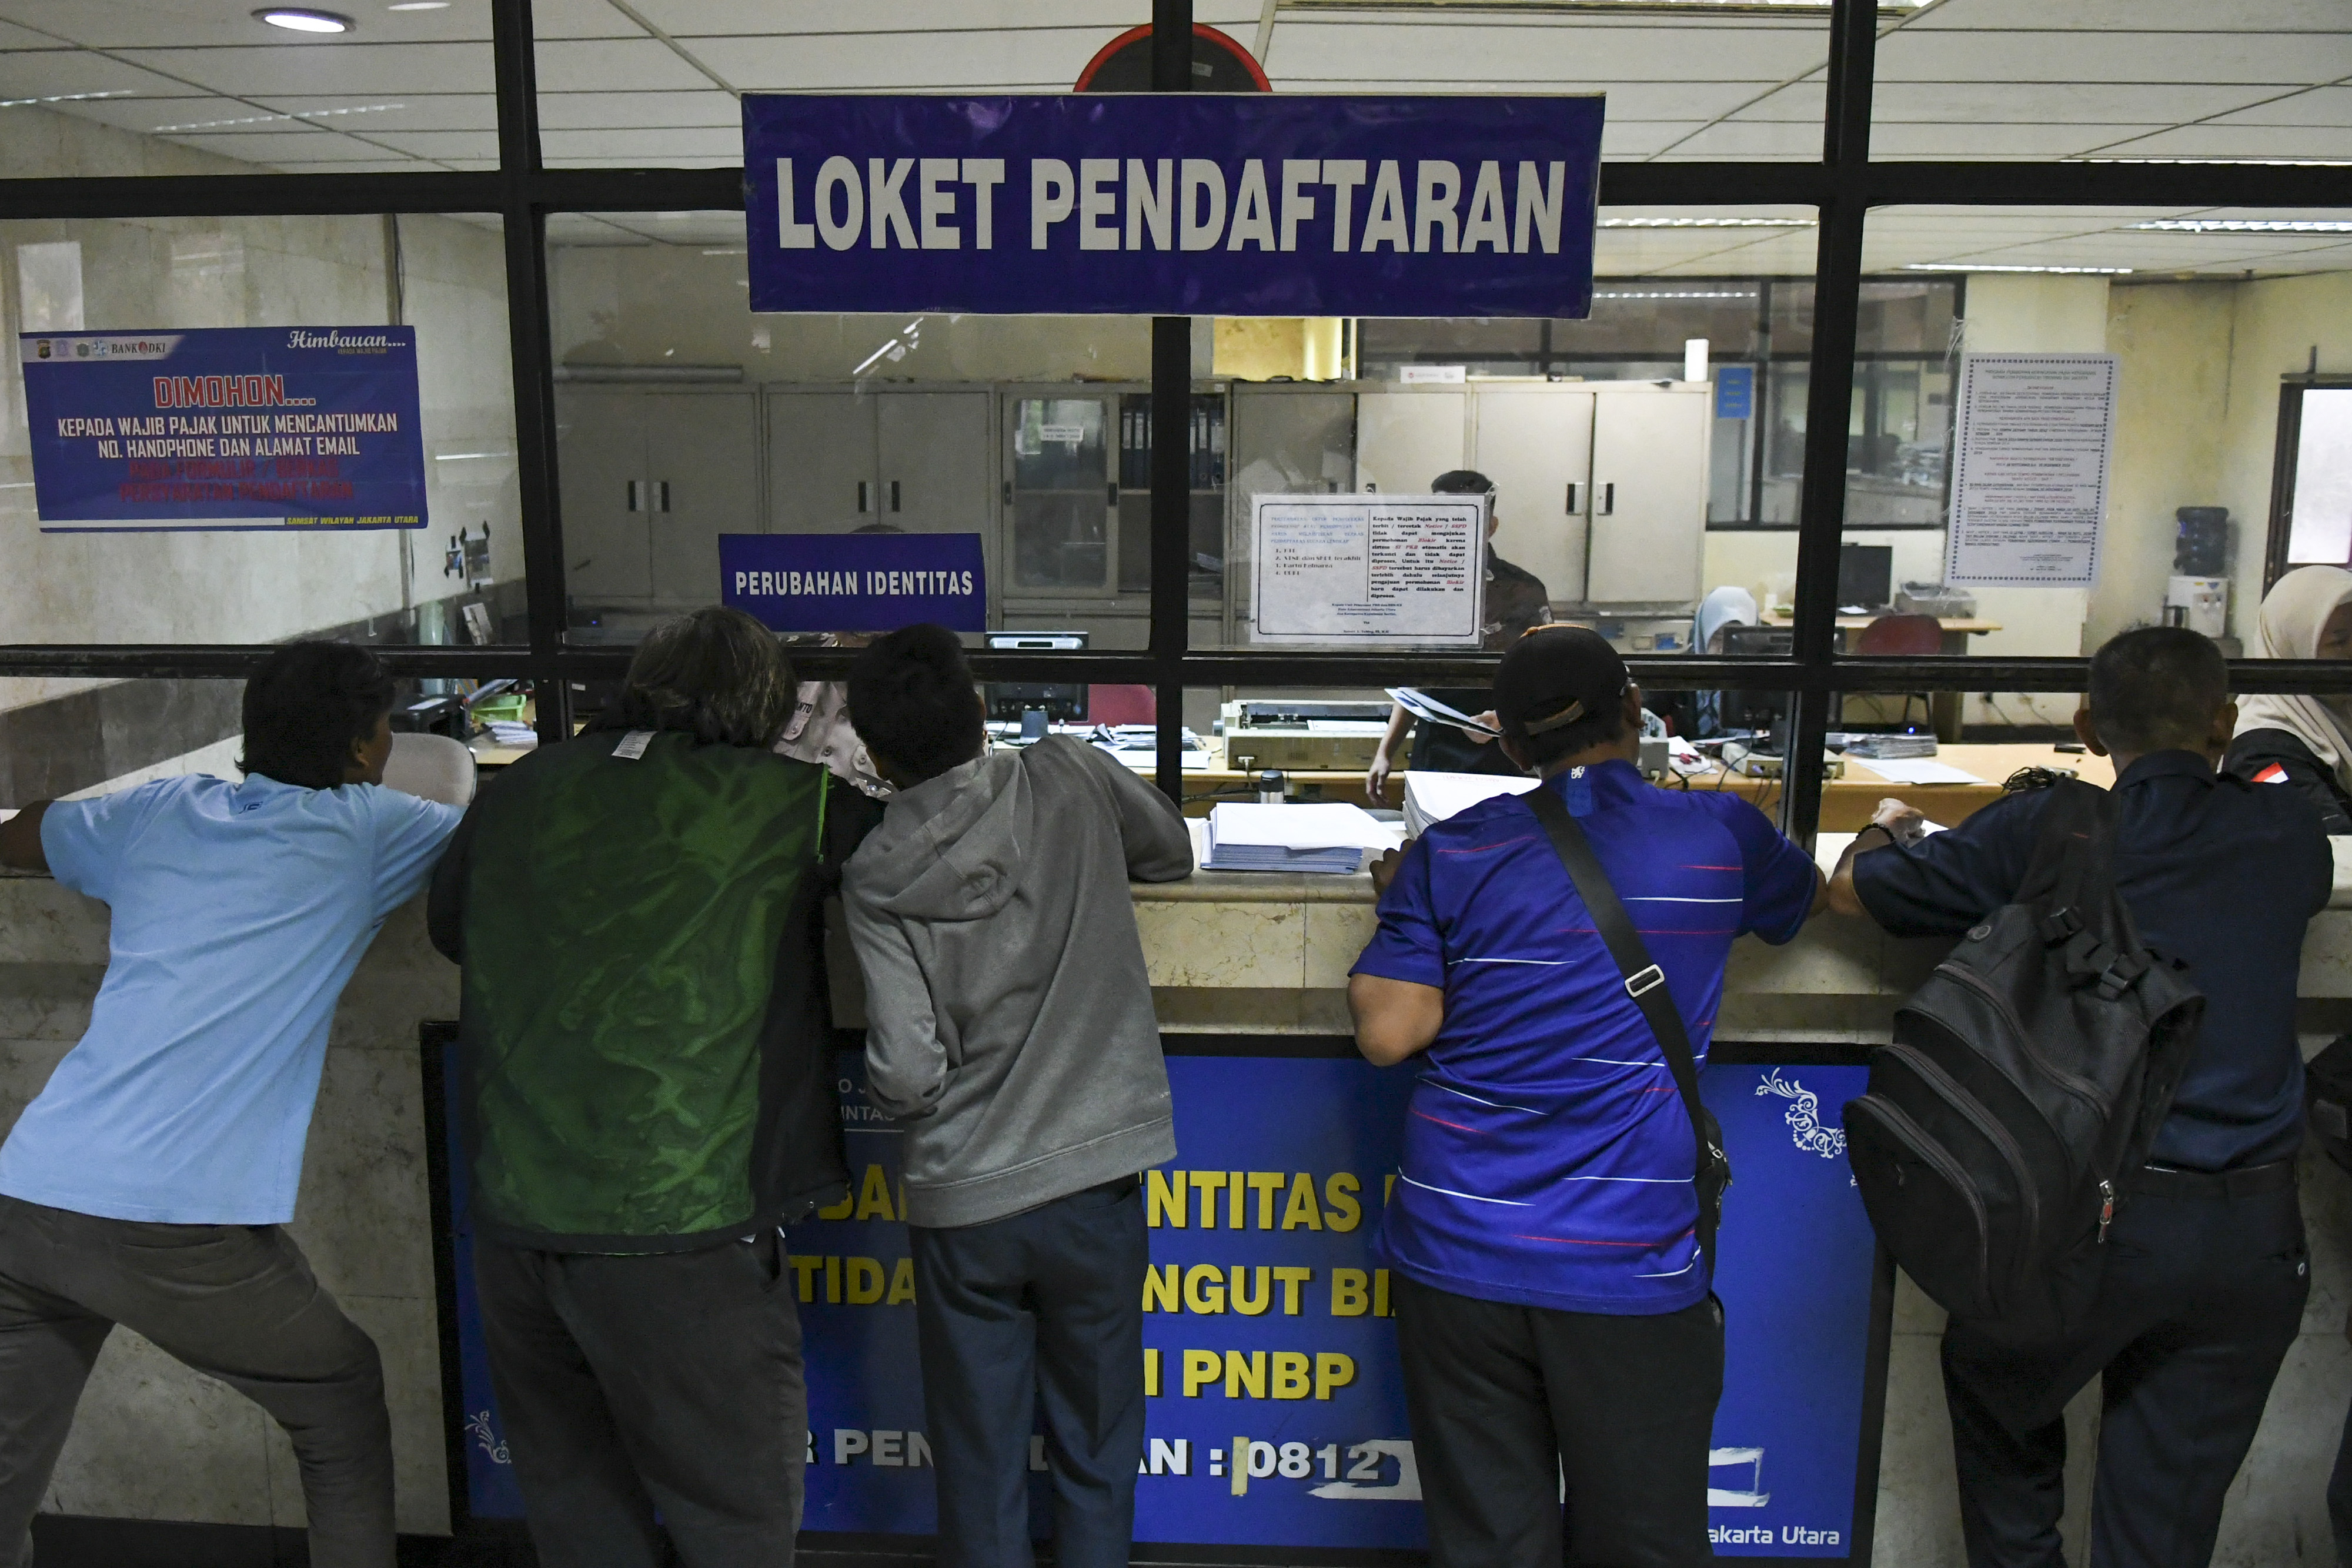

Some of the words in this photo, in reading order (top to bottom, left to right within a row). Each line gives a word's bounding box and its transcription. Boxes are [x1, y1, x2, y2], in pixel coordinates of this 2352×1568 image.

[776, 155, 1006, 253] LOKET
[1031, 158, 1566, 256] PENDAFTARAN
[111, 342, 140, 354] BANK
[148, 342, 166, 353] DKI
[58, 418, 115, 437] KEPADA
[118, 417, 165, 436] WAJIB
[169, 416, 217, 436] PAJAK
[221, 415, 270, 434] UNTUK
[275, 413, 397, 434] MENCANTUMKAN
[99, 440, 123, 459] NO.
[127, 439, 216, 458] HANDPHONE
[219, 439, 249, 457] DAN
[255, 437, 313, 456] ALAMAT
[317, 437, 360, 456] EMAIL
[175, 460, 256, 479] FORMULIR
[238, 482, 353, 500] PENDAFTARAN
[736, 571, 857, 595] PERUBAHAN
[867, 571, 973, 595] IDENTITAS
[1140, 1170, 1361, 1232] NTITAS
[1331, 1268, 1395, 1317] BI
[1183, 1349, 1354, 1400] PNBP
[1782, 1526, 1839, 1545] Utara
